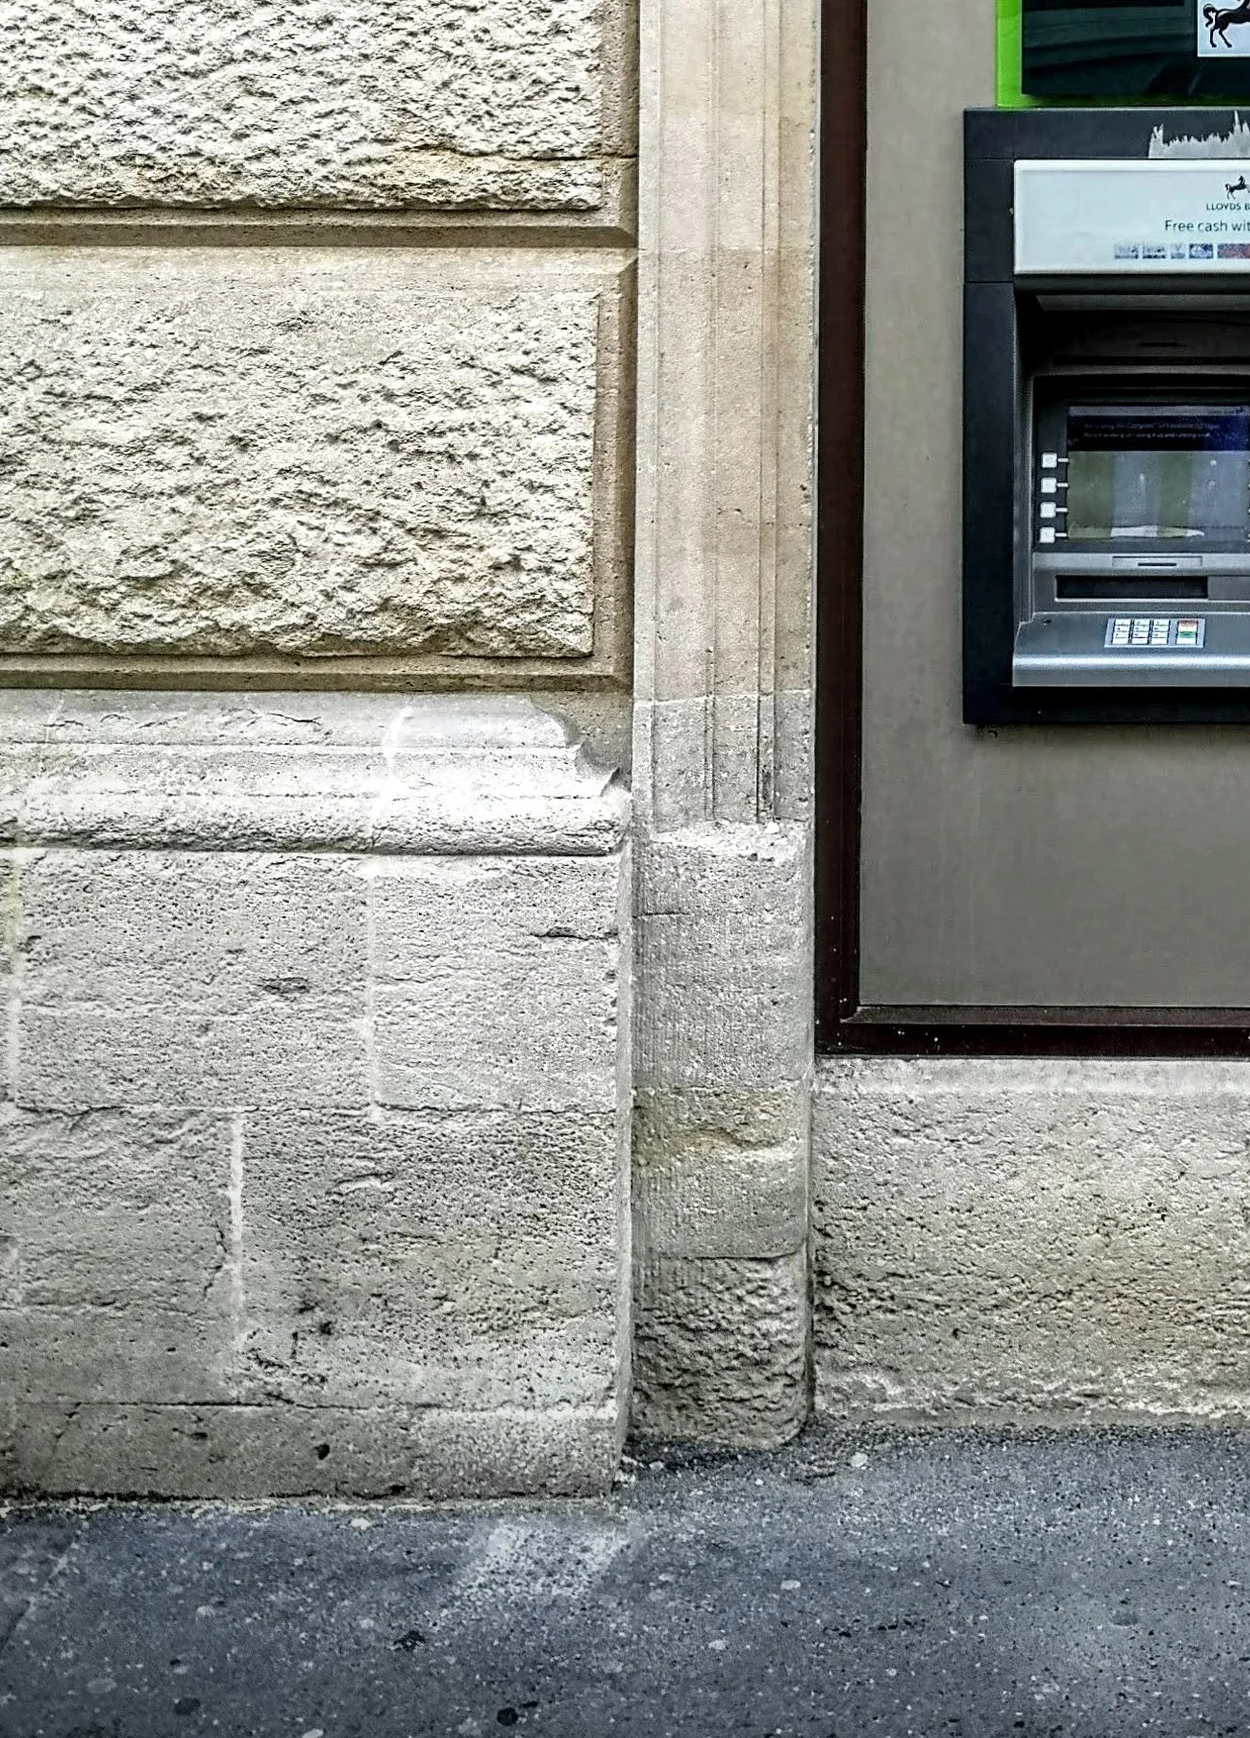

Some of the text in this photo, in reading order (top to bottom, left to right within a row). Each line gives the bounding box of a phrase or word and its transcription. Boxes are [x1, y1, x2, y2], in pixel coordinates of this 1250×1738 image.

[1206, 202, 1242, 211] LLOYDS
[1164, 219, 1194, 232] Free
[1197, 219, 1228, 232] cash
